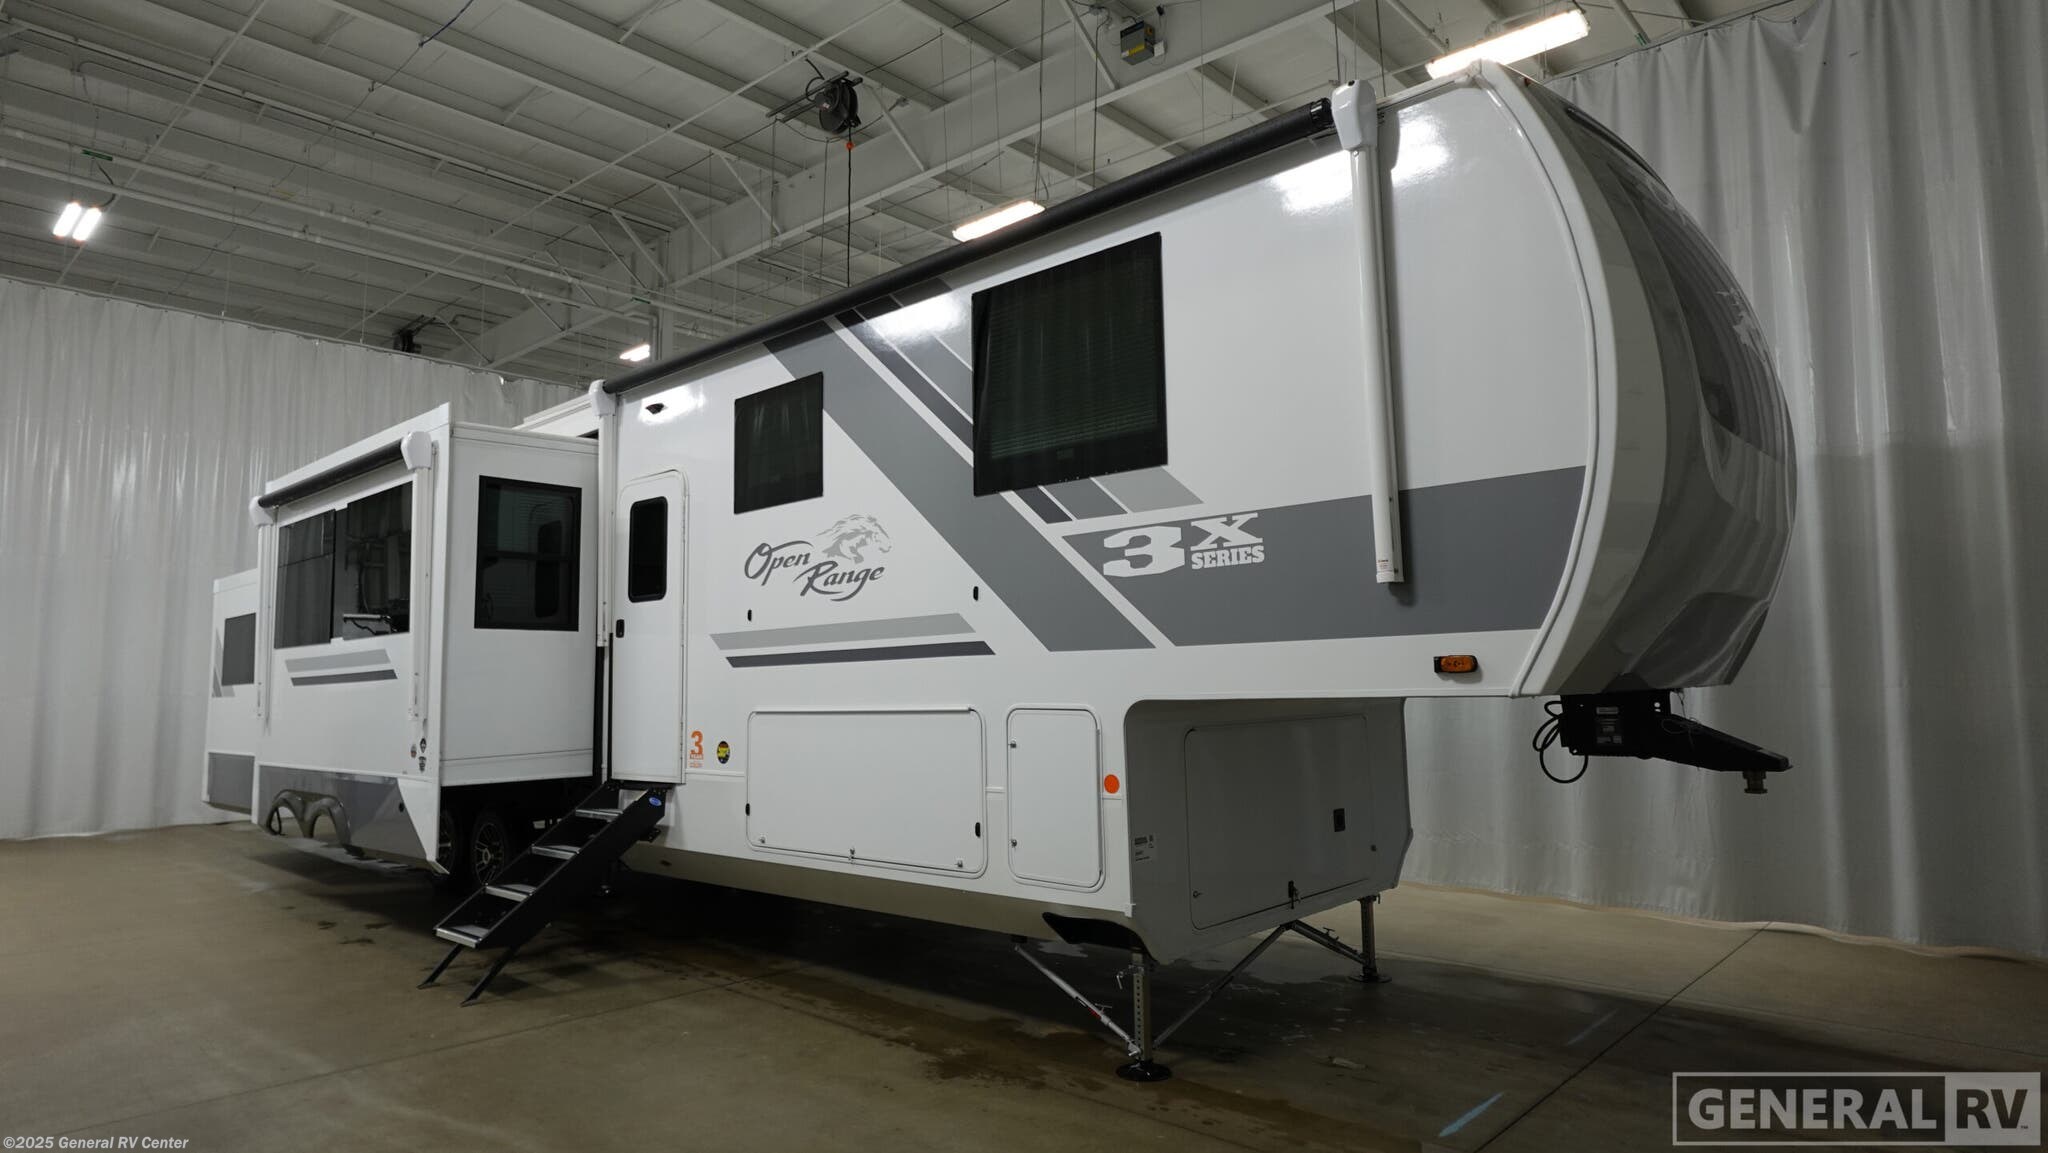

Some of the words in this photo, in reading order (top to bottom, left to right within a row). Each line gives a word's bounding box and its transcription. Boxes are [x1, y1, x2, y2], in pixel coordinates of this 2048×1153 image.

[744, 540, 814, 587] Open
[1103, 525, 1185, 578] 3
[1190, 512, 1263, 551] X
[1191, 545, 1265, 570] SERIES
[791, 560, 885, 602] Range
[690, 730, 703, 755] 3
